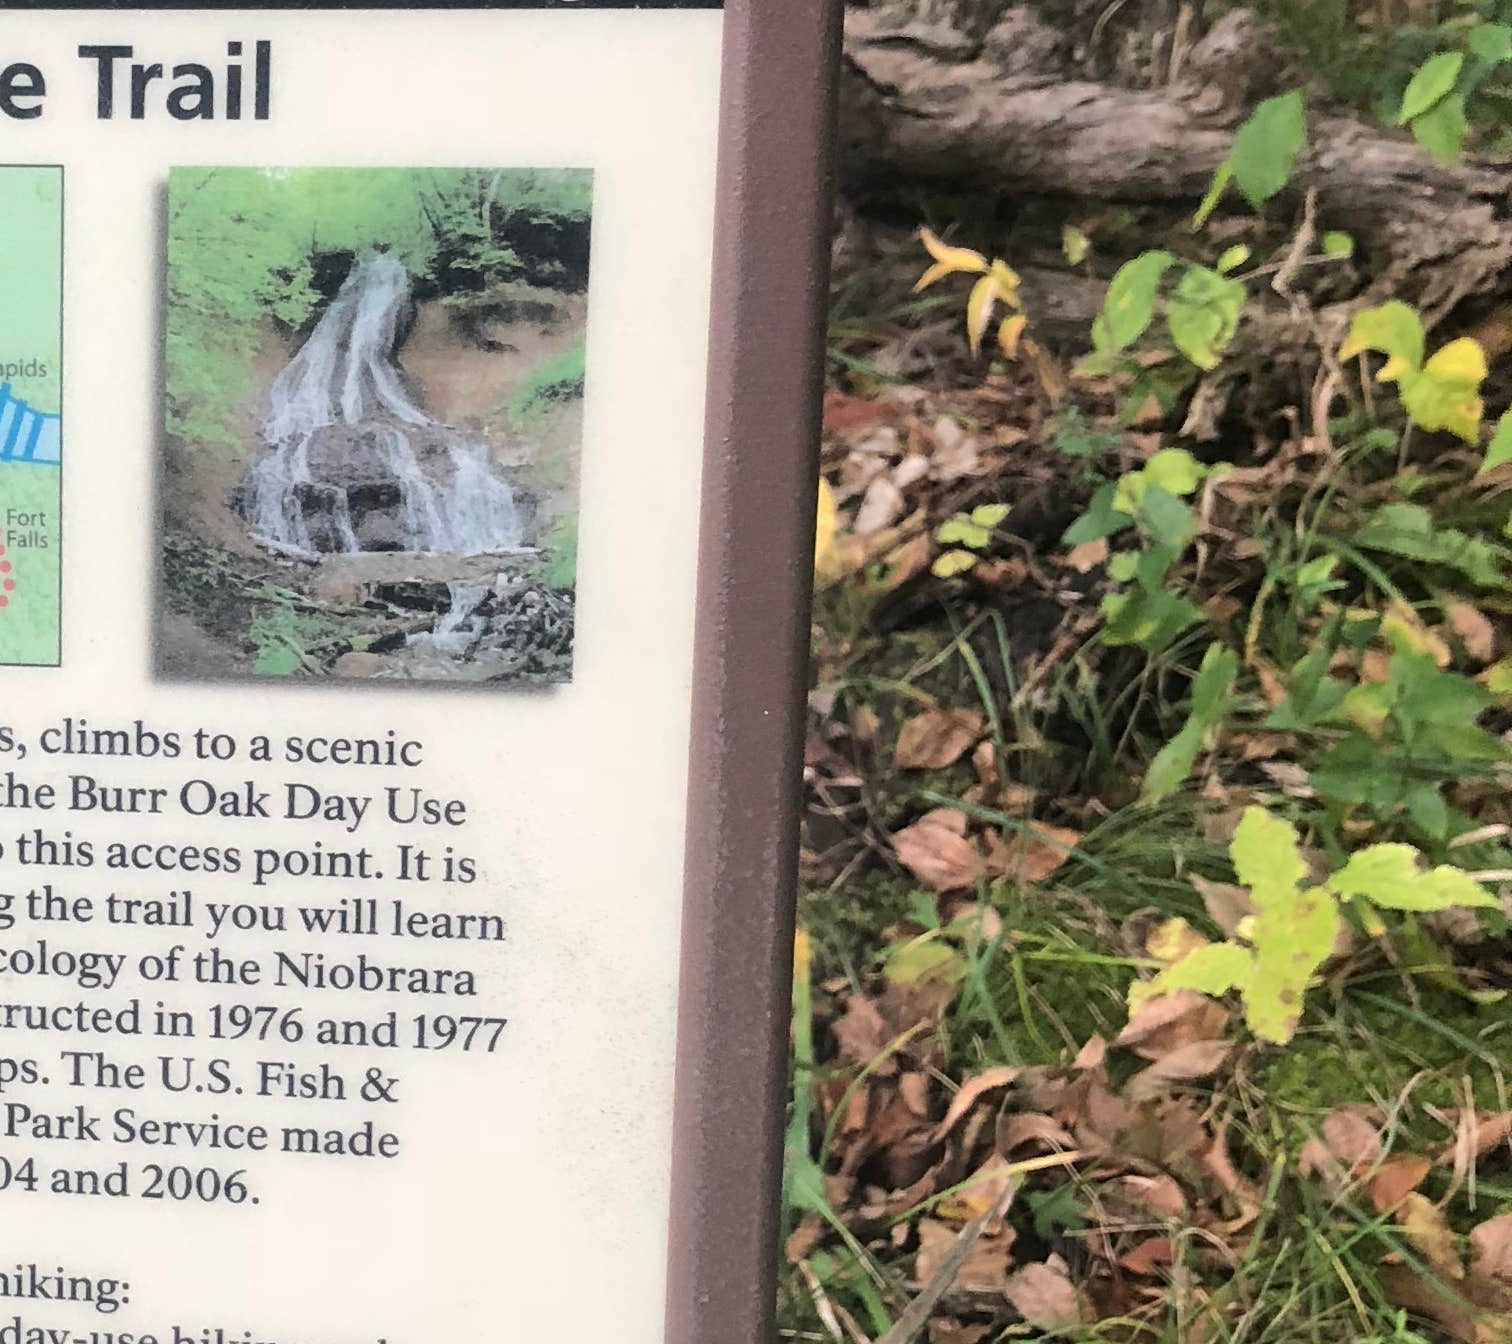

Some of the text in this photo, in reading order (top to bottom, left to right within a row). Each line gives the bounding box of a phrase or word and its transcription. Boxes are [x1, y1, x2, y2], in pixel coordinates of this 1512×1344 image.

[78, 40, 271, 120] Trail
[7, 508, 46, 527] Fort
[7, 529, 48, 549] Falls
[40, 718, 181, 758] climbs
[193, 728, 236, 760] to
[250, 736, 272, 761] a
[286, 730, 422, 766] scenic
[68, 776, 167, 813] Burr
[180, 780, 270, 817] Oak
[284, 784, 372, 832] Day
[384, 787, 466, 826] Use
[16, 829, 93, 867] this
[107, 843, 241, 873] access
[253, 841, 383, 885] point.
[397, 845, 431, 881] It
[443, 847, 476, 883] is
[26, 885, 93, 922] the
[106, 891, 193, 926] trail
[205, 904, 287, 939] you
[298, 898, 378, 935] will
[392, 900, 505, 941] learn
[154, 1001, 195, 1037] in
[209, 1004, 303, 1042] 1976
[317, 1012, 398, 1047] and
[413, 1015, 507, 1052] 1977
[61, 1051, 144, 1089] The
[158, 1057, 242, 1095] U.S.
[257, 1062, 346, 1100] Fish
[360, 1068, 399, 1102] &
[51, 1162, 130, 1196] and
[141, 1164, 259, 1204] 2006.
